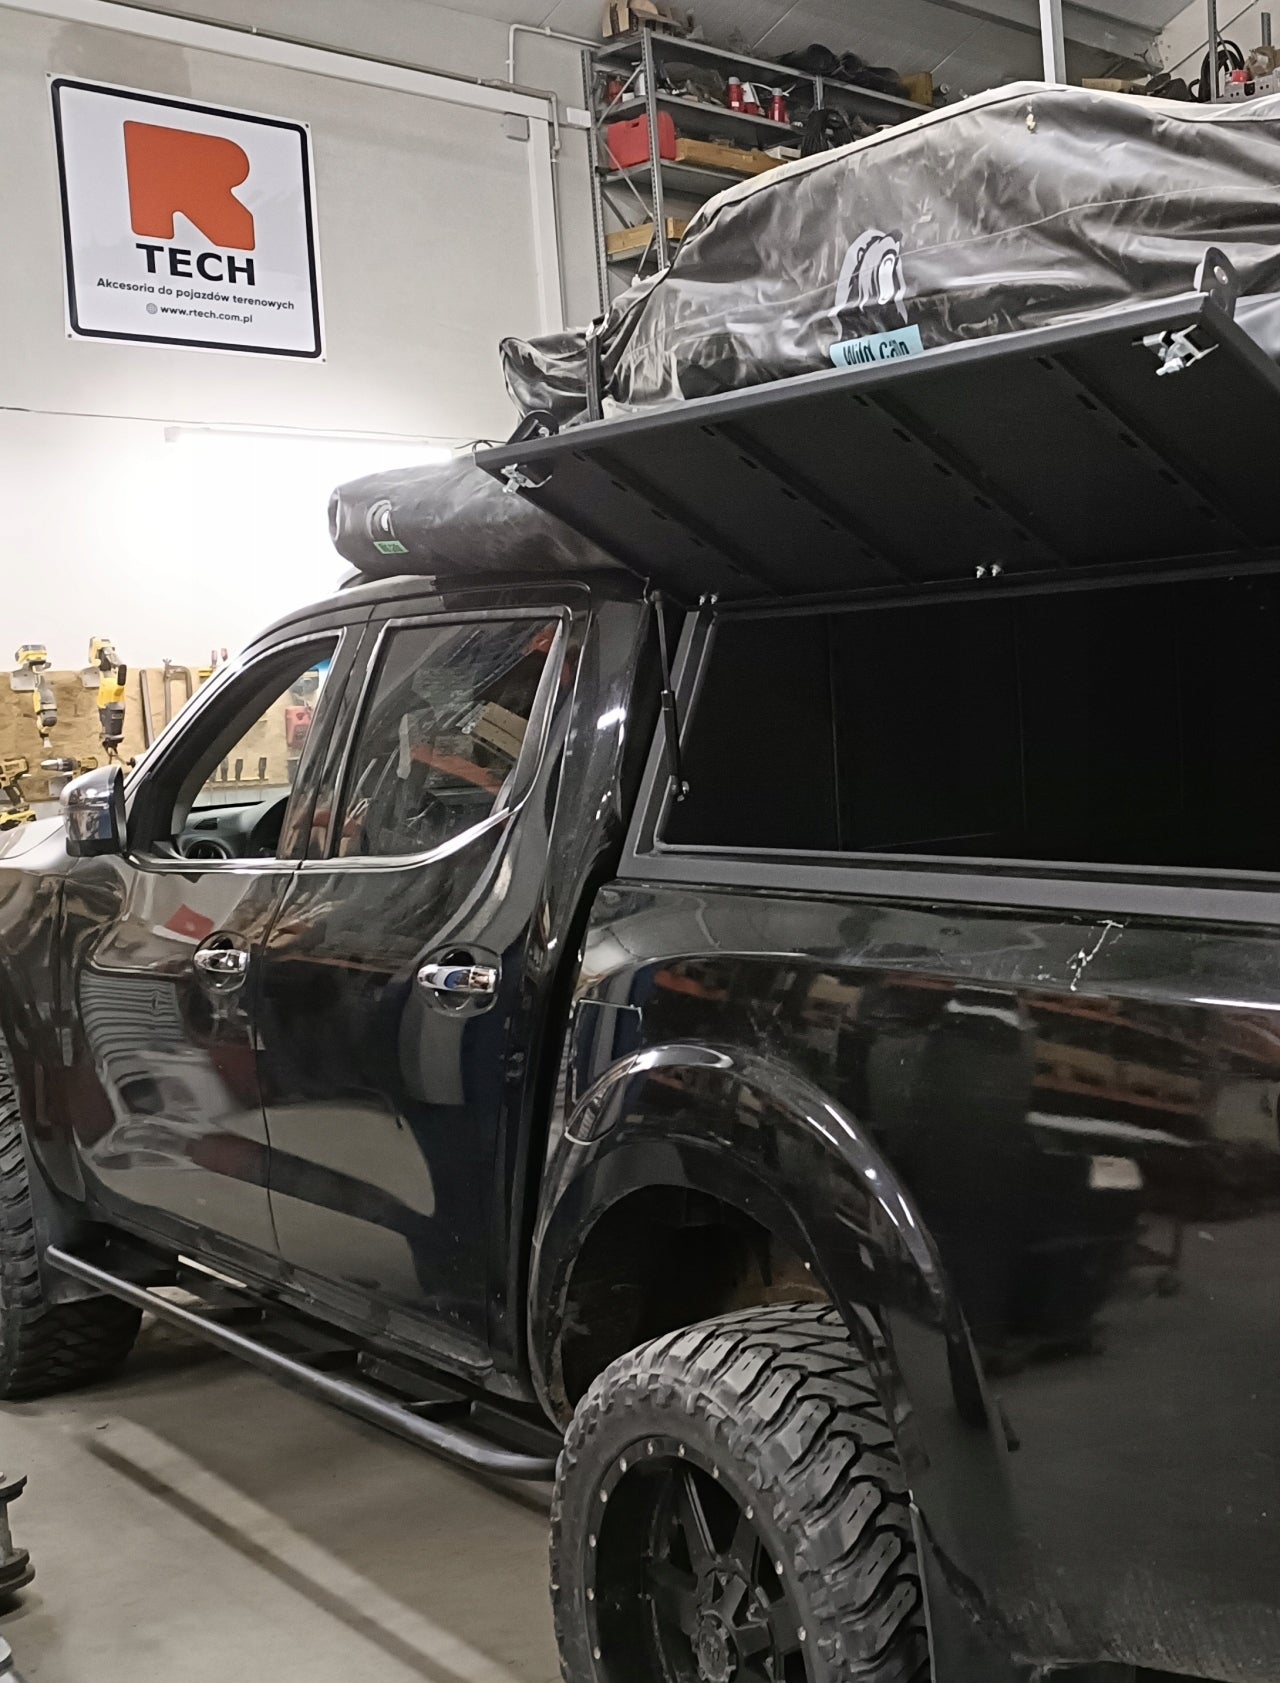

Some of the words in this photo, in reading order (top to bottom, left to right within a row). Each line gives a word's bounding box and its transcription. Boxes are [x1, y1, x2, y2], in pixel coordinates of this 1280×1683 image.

[123, 120, 256, 251] R
[135, 242, 256, 286] TECH
[97, 278, 155, 293] Akcesoria
[157, 285, 173, 295] do
[175, 288, 230, 302] pojazdów
[232, 294, 295, 310] terenowych
[160, 306, 253, 324] www.rtech.com.pl
